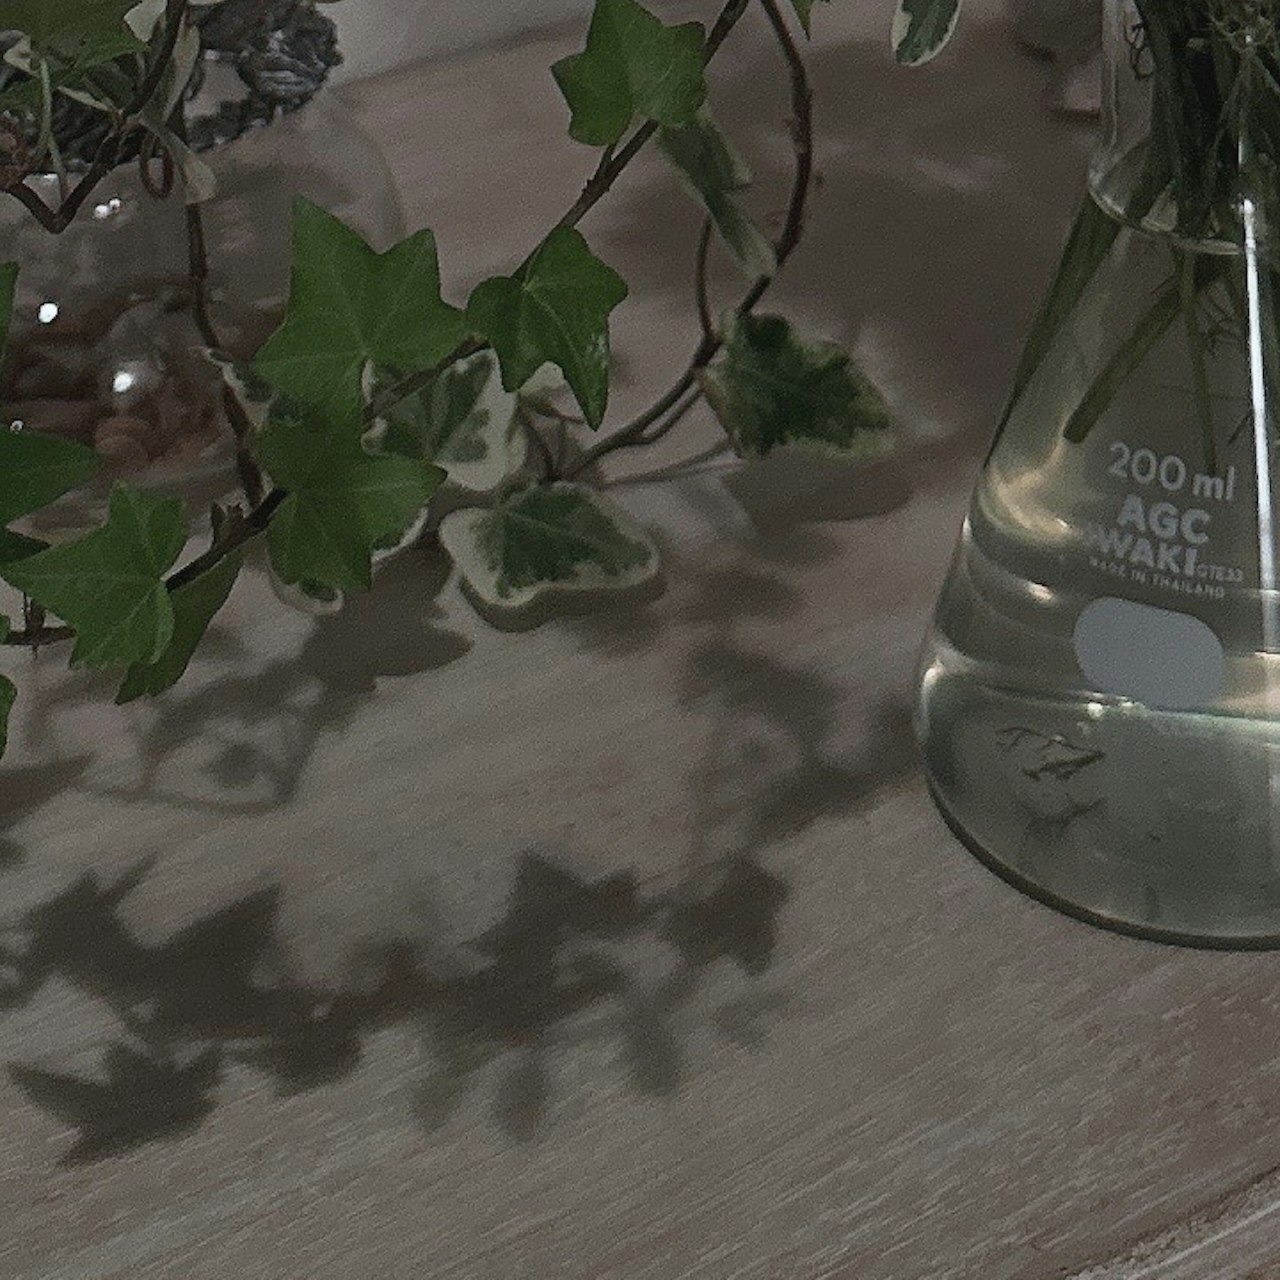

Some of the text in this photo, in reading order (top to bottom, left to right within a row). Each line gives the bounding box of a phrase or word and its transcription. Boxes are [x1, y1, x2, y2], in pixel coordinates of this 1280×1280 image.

[1108, 441, 1236, 501] 200 ml
[1116, 494, 1212, 544] AGC
